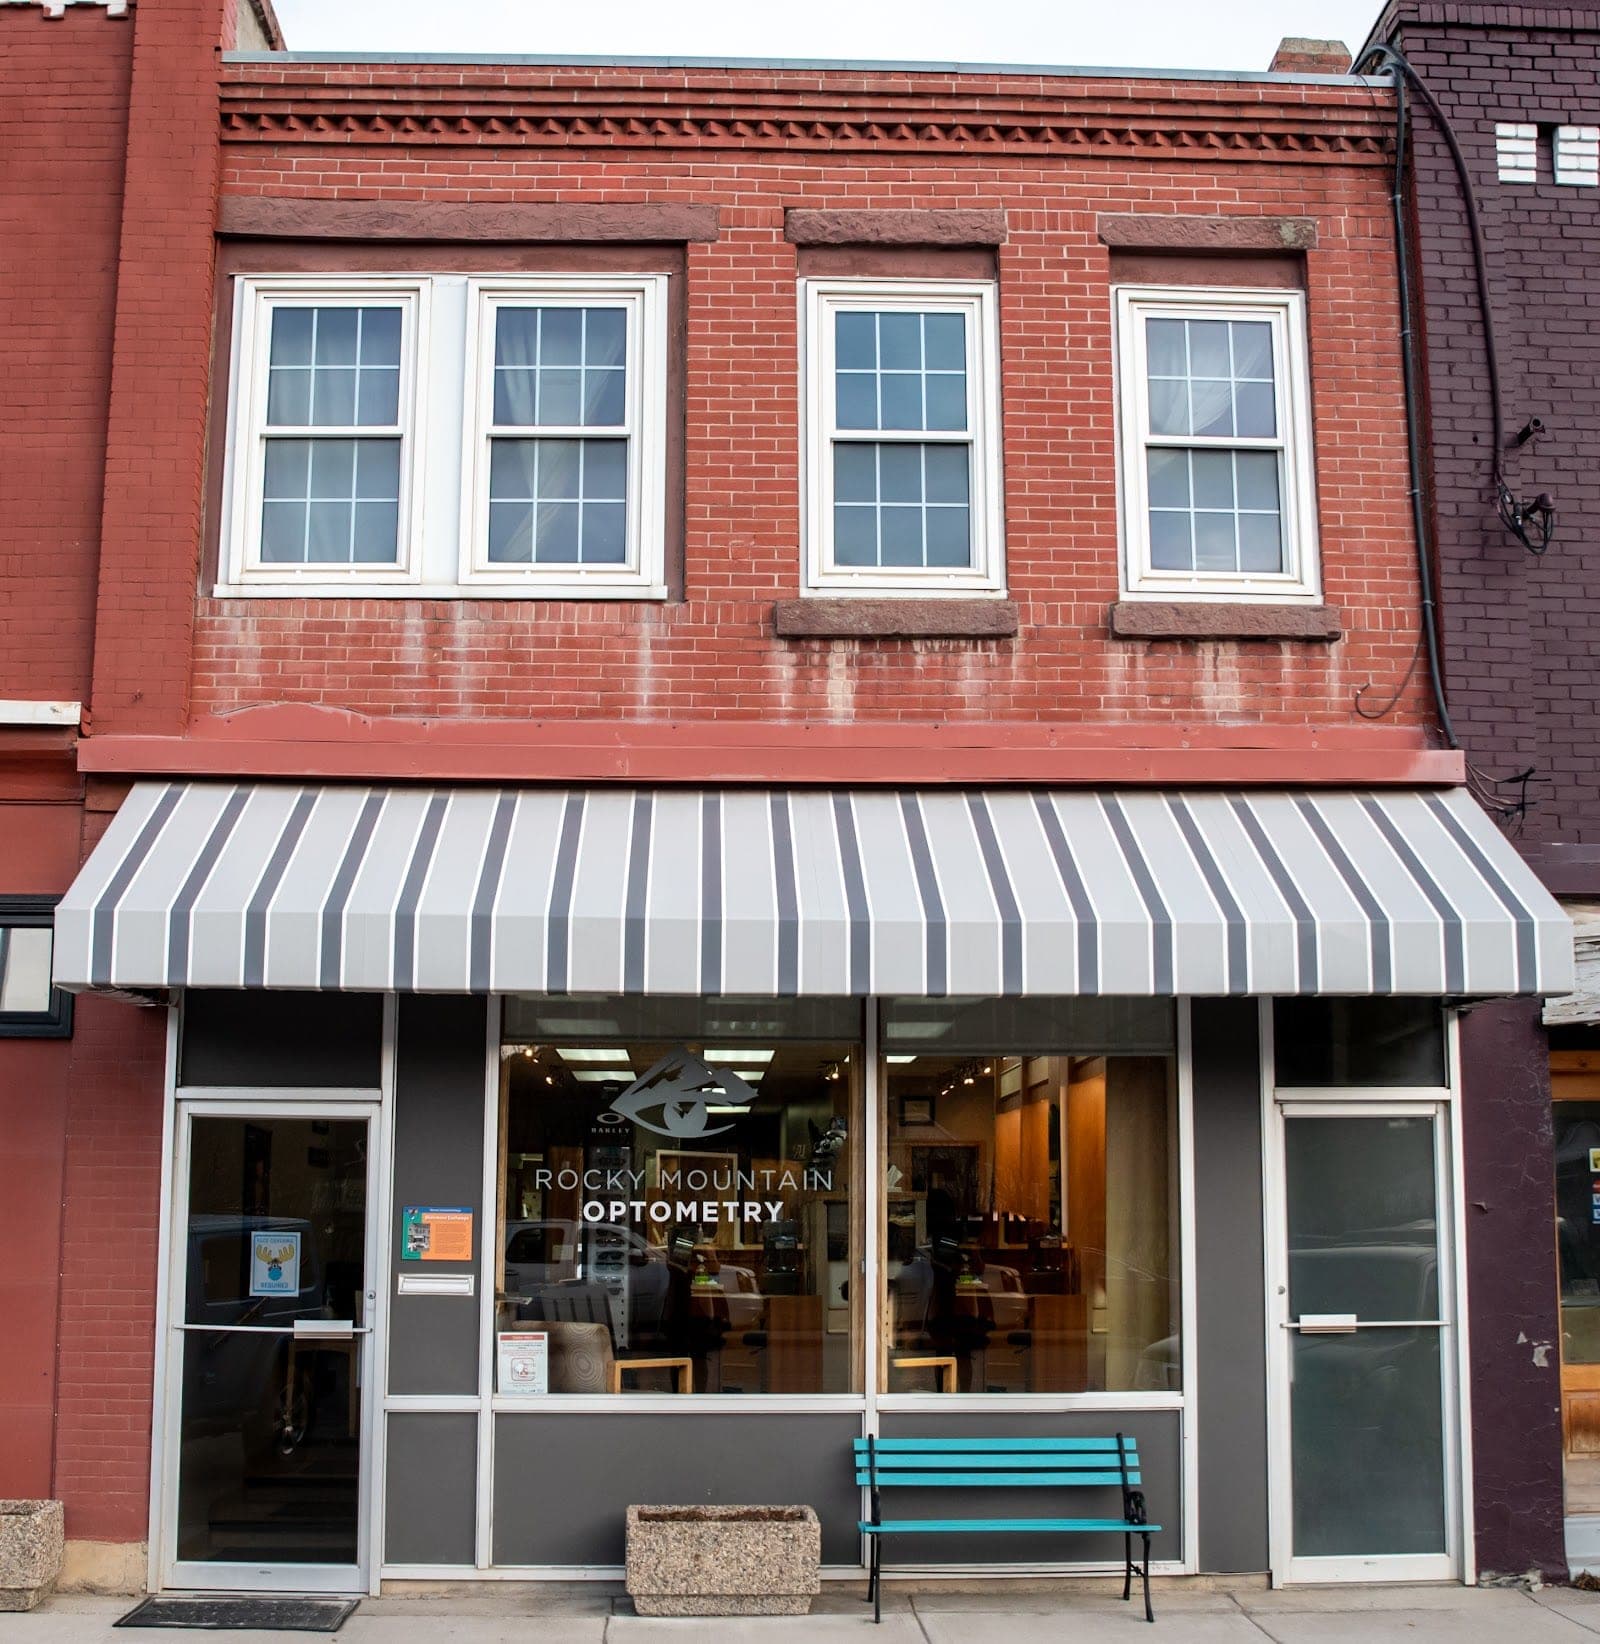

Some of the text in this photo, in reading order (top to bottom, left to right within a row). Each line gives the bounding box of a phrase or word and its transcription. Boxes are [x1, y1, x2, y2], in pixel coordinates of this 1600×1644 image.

[535, 1169, 833, 1191] ROCKY MOUNTAIN
[583, 1200, 784, 1223] OPTOMETRY
